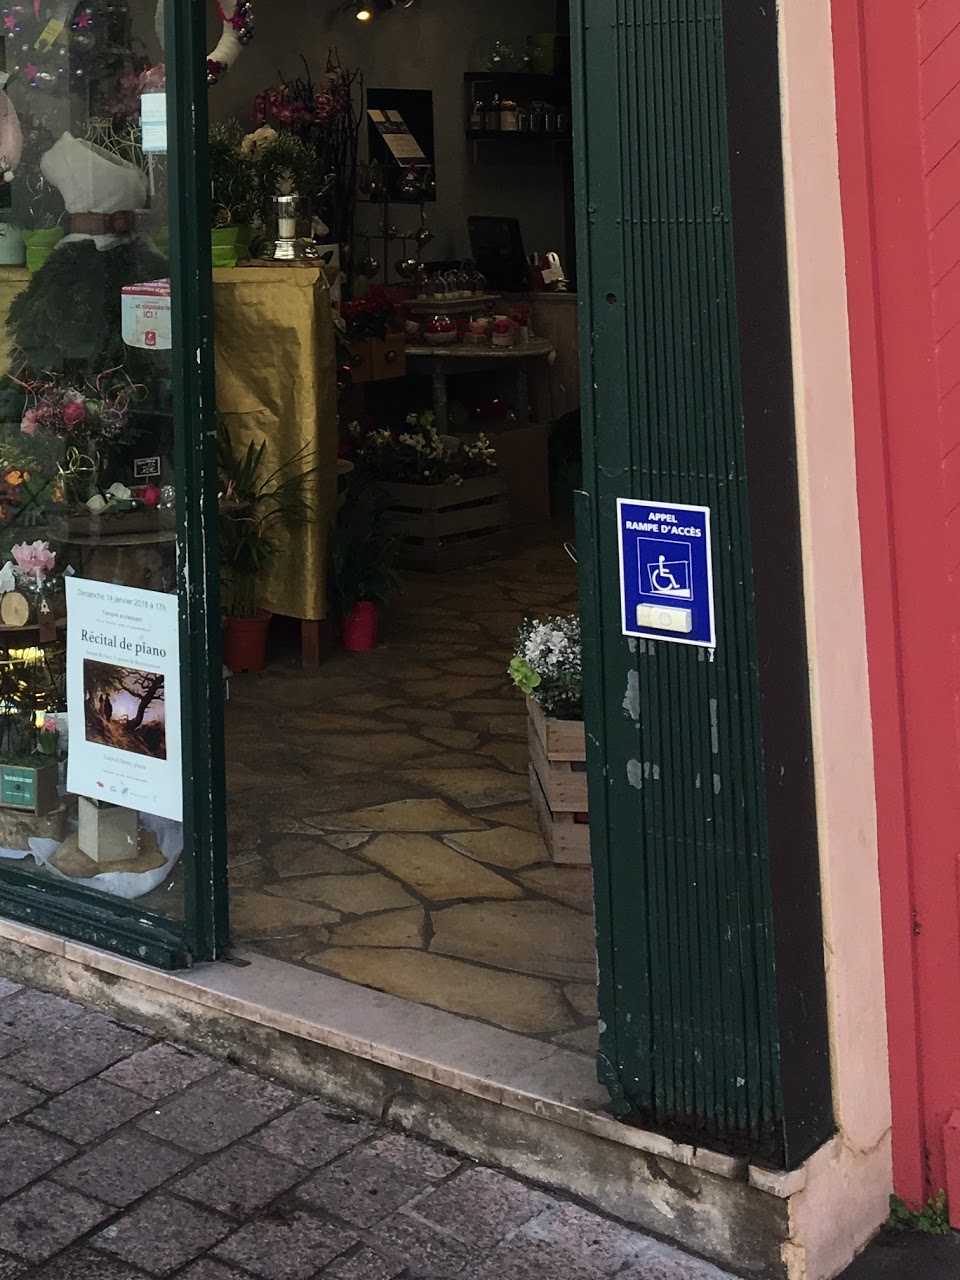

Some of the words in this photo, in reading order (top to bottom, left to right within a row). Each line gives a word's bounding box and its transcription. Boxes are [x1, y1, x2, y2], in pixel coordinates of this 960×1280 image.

[648, 512, 678, 523] APPEL
[625, 521, 659, 533] RAMPE
[661, 524, 702, 538] D'ACCÈS
[77, 588, 105, 601] Dimanche
[106, 593, 113, 601] 14
[114, 596, 133, 605] janvier
[134, 599, 149, 608] 2018
[155, 602, 167, 612] 17h
[81, 628, 117, 648] Récital
[119, 637, 133, 651] de
[135, 641, 167, 658] piano
